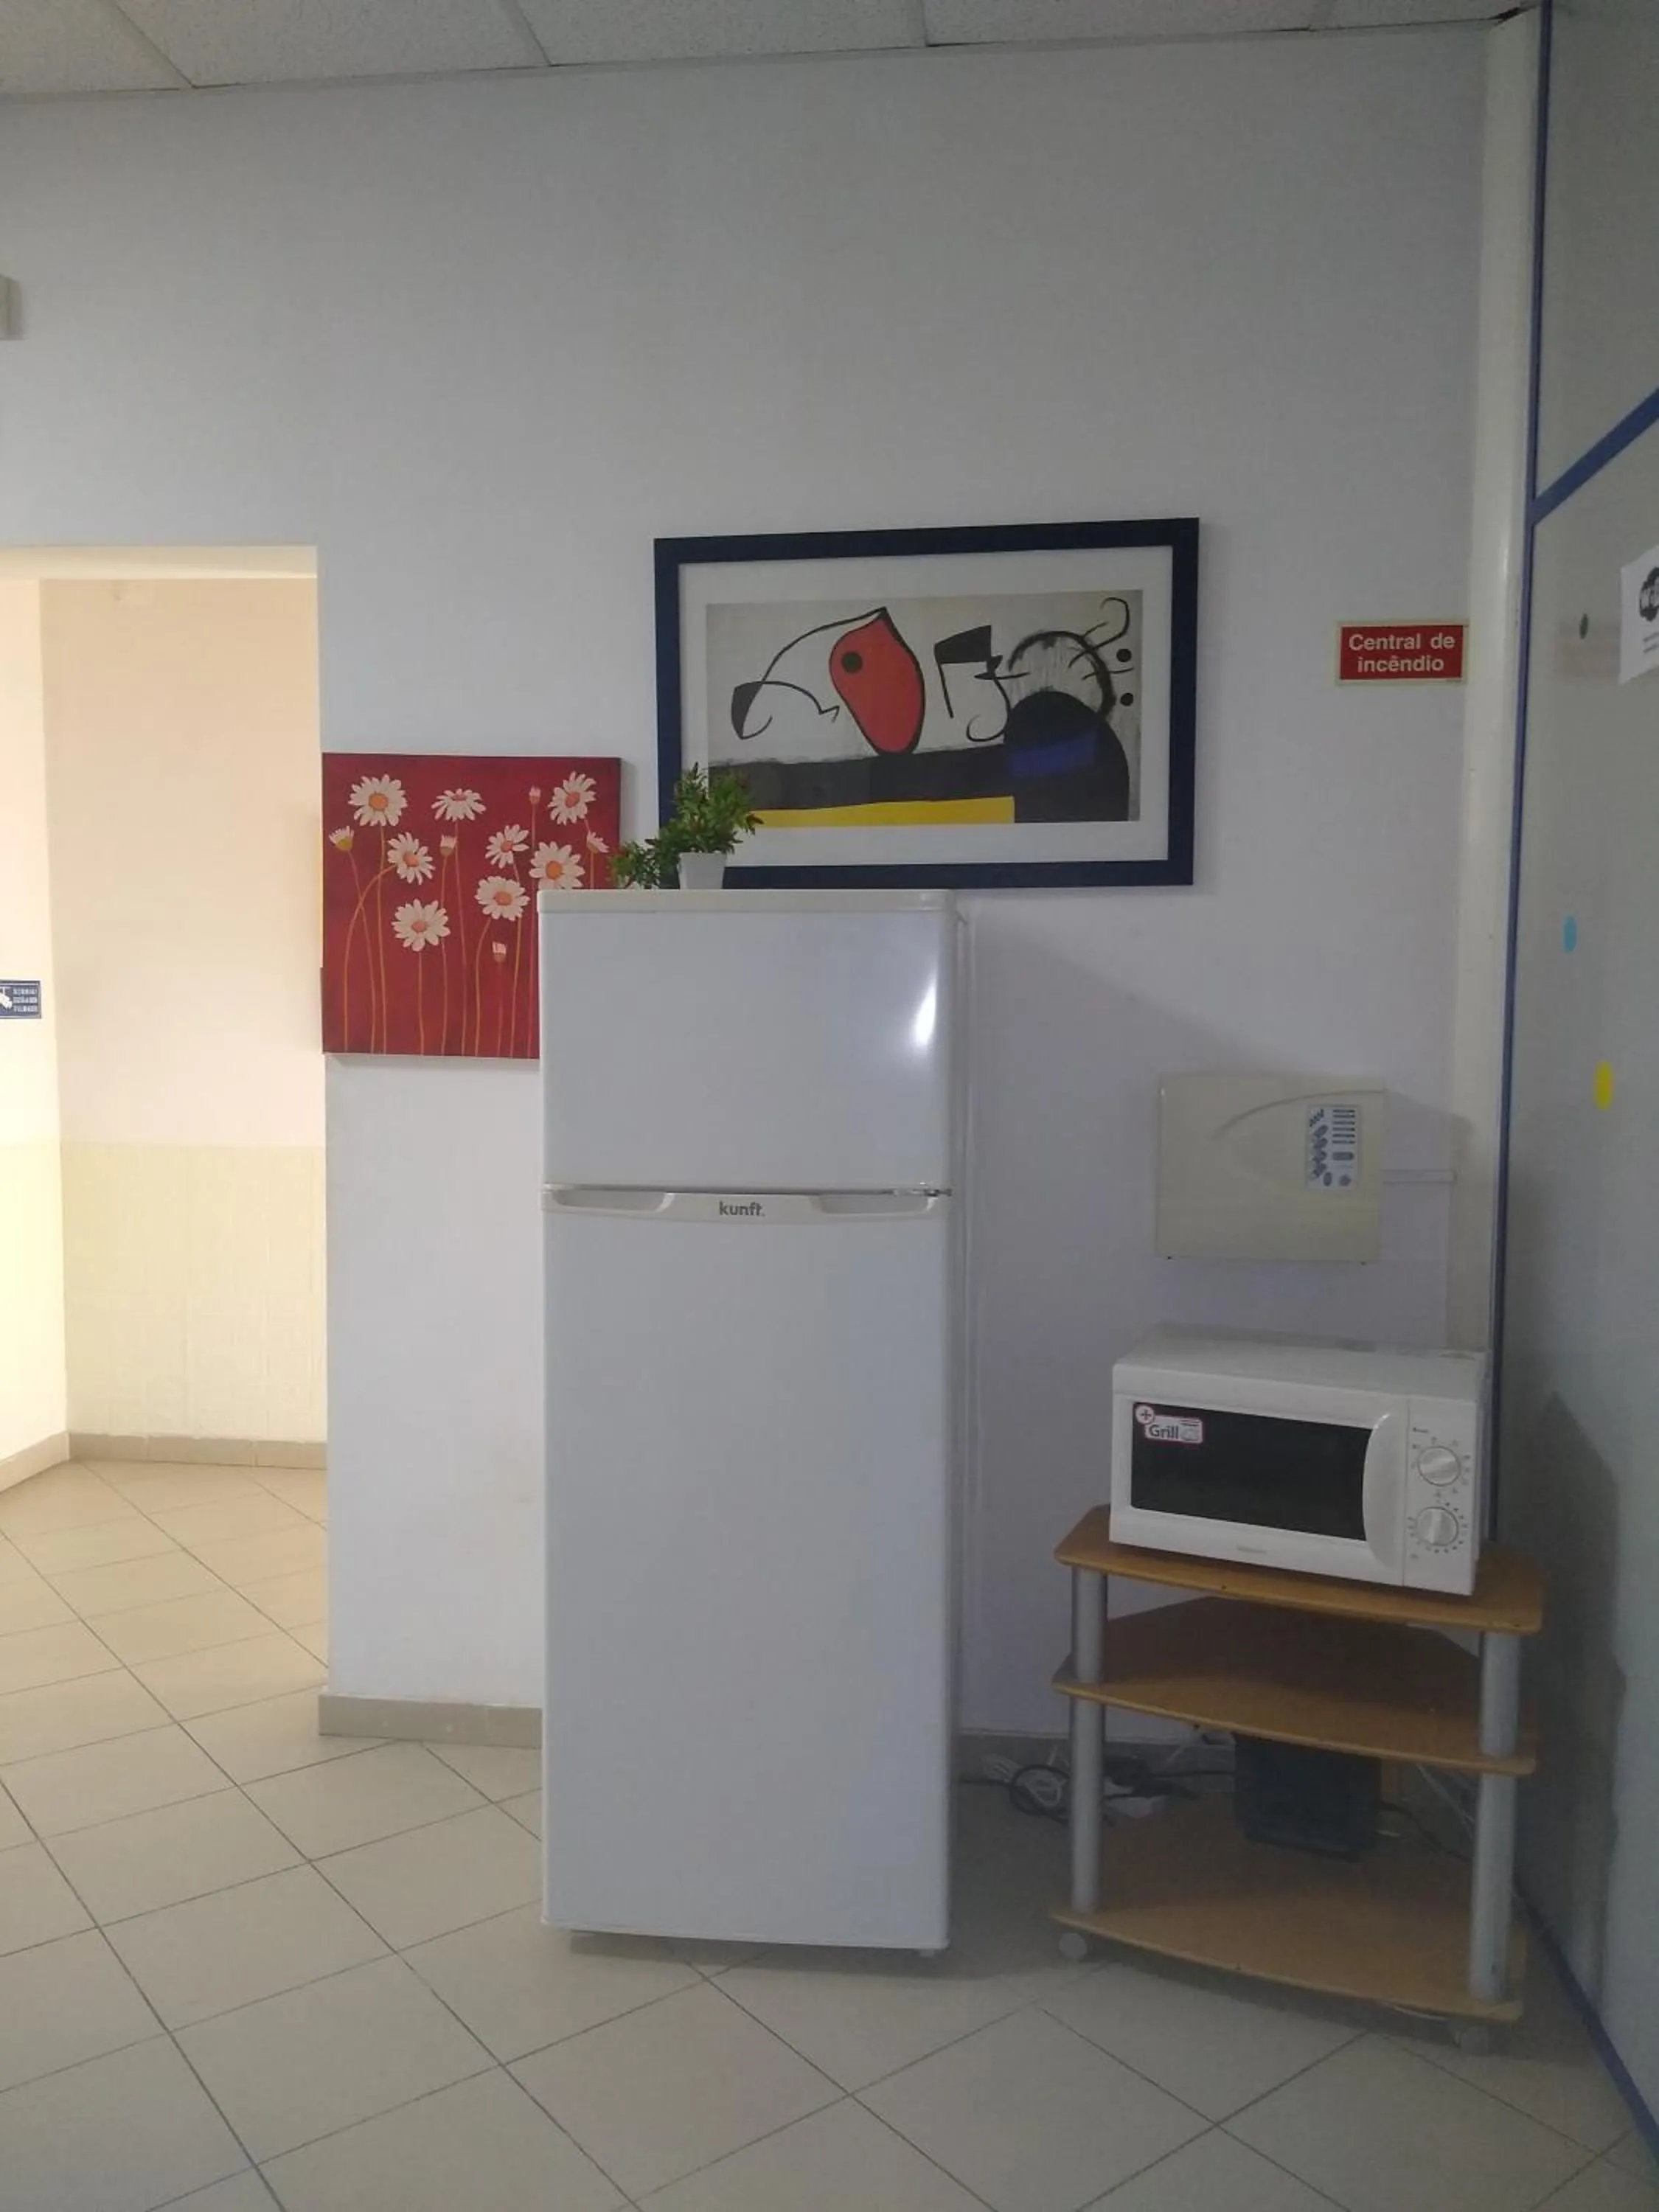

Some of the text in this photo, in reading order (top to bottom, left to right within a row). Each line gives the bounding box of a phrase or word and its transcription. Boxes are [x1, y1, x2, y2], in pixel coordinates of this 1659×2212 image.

[1349, 632, 1455, 651] Central de
[1357, 655, 1445, 673] incêndio
[1150, 1424, 1179, 1440] Grill
